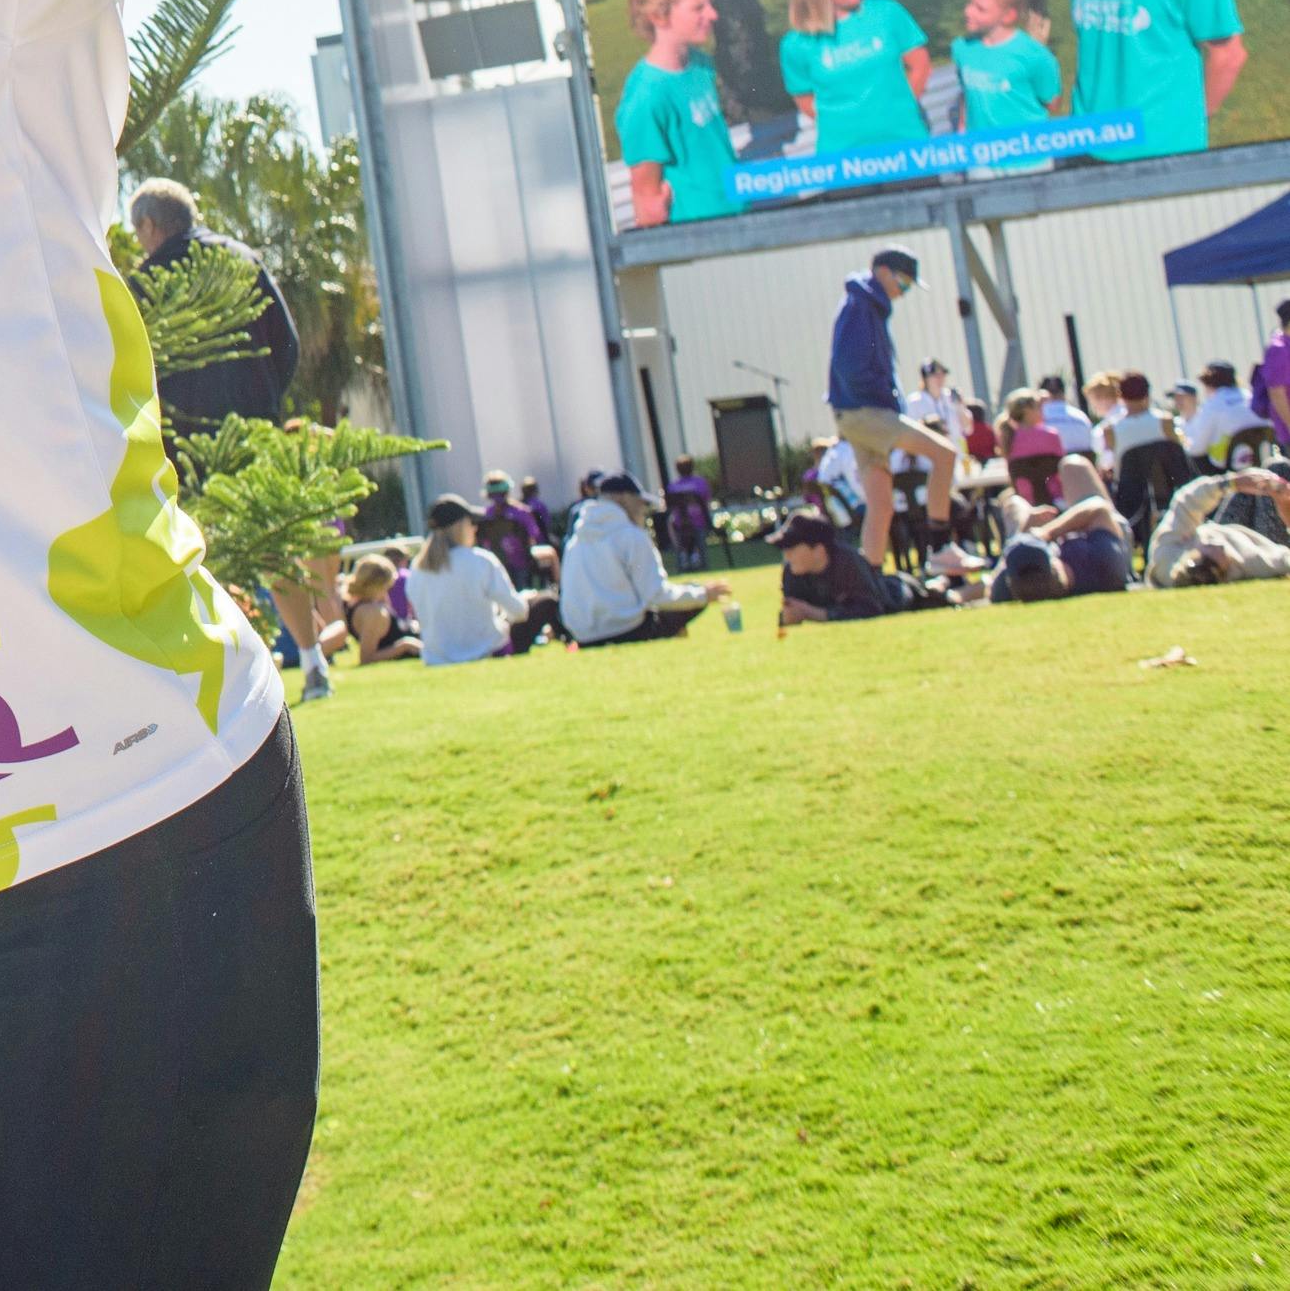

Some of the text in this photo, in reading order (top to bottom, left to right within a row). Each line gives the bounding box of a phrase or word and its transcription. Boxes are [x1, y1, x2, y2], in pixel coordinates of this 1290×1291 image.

[734, 121, 1136, 196] Register Now! Visit gpcl.com.au
